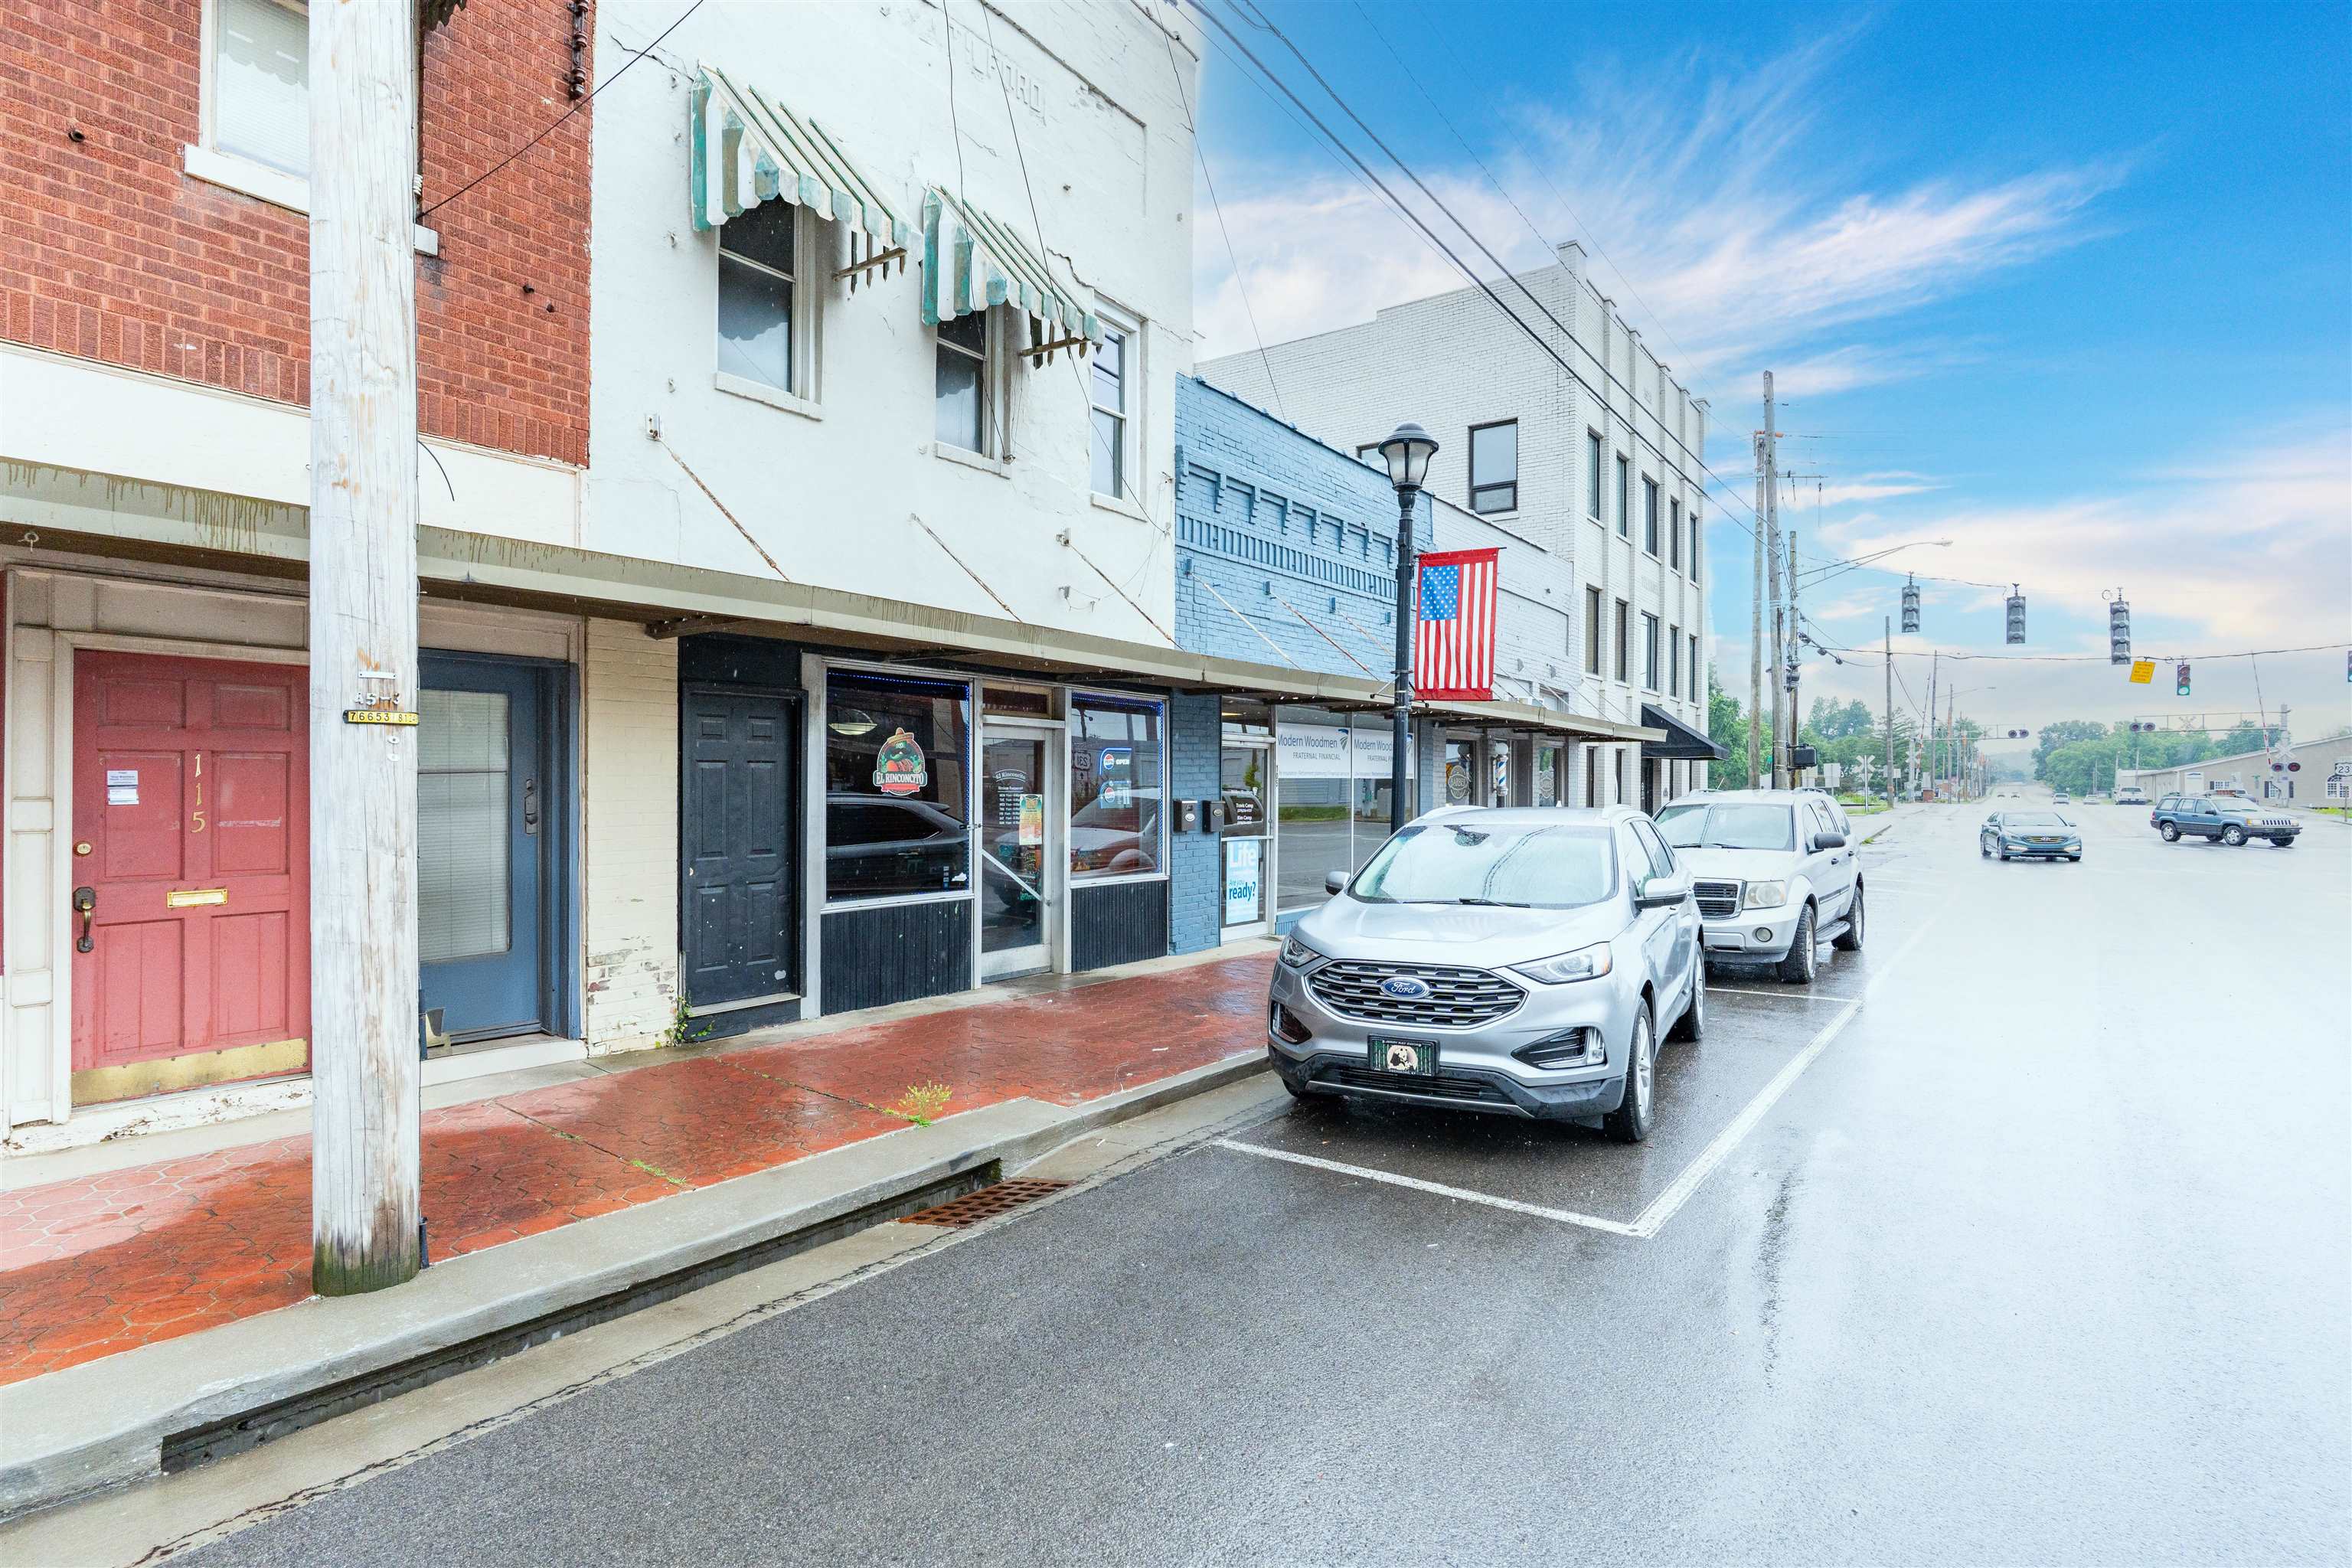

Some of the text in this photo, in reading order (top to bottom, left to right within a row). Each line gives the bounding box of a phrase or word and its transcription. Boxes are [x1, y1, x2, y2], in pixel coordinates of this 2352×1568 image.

[350, 712, 390, 721] 76653
[1305, 735, 1338, 748] Woodmen
[1354, 739, 1393, 752] Modern Wood
[1292, 752, 1318, 760] FRATERNAL
[876, 771, 923, 784] EL RINCONCITO
[190, 753, 206, 833] 115
[1230, 841, 1256, 867] Life
[1229, 881, 1256, 901] ready?
[1391, 982, 1416, 994] Ford
